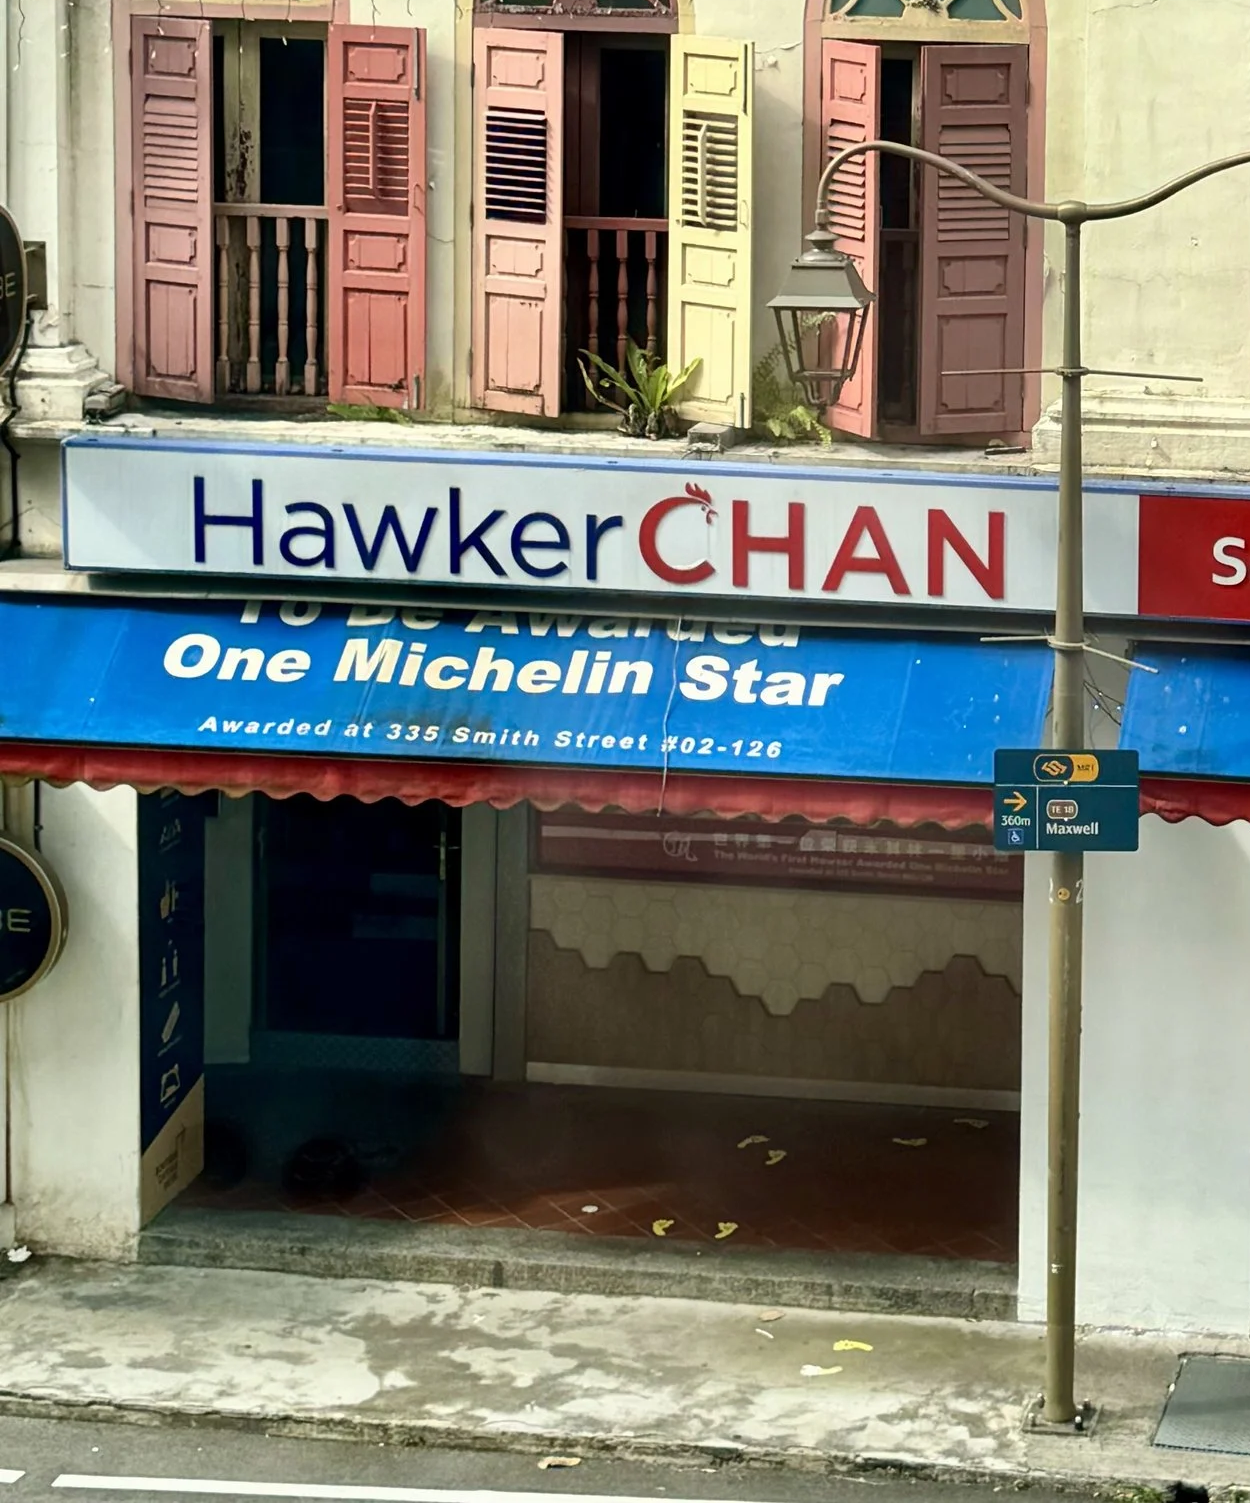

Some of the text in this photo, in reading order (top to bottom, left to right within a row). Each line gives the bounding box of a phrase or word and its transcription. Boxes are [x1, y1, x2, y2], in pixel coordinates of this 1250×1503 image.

[163, 633, 844, 707] One Michelin Star
[198, 716, 783, 759] Awarded at 335 Smith Street #02-126
[1001, 815, 1031, 826] 360m
[1046, 822, 1099, 835] Maxwell
